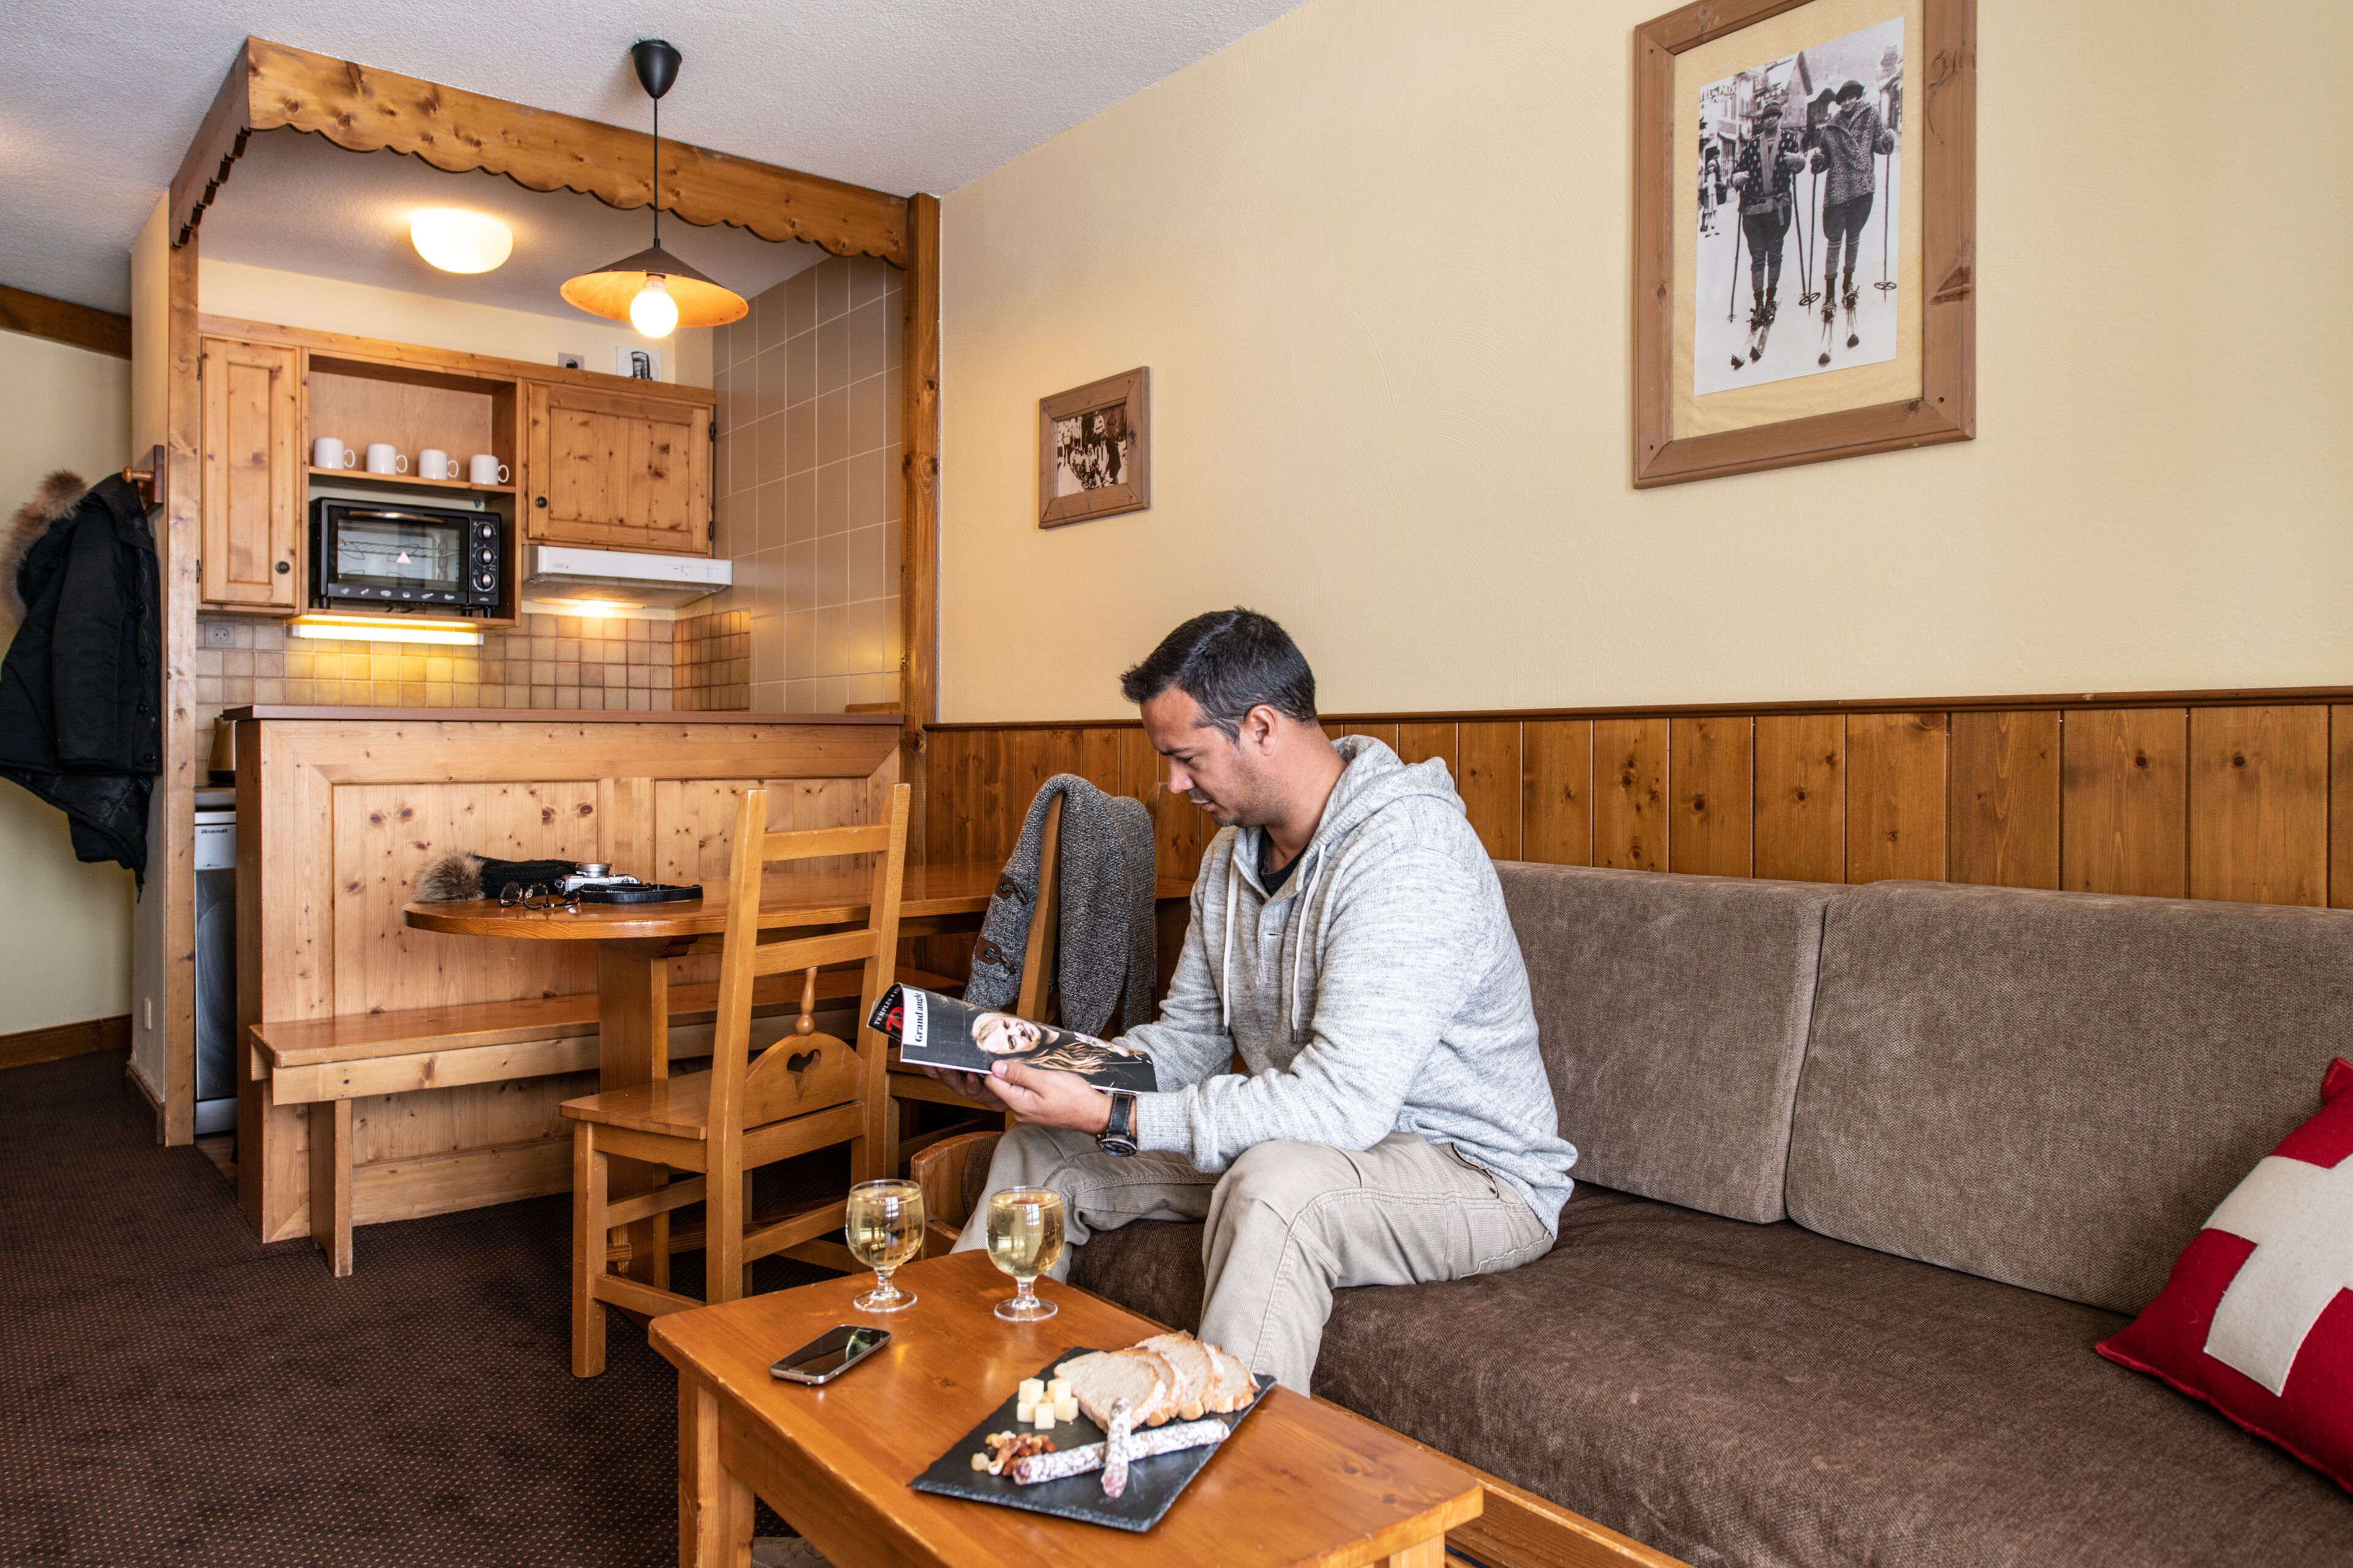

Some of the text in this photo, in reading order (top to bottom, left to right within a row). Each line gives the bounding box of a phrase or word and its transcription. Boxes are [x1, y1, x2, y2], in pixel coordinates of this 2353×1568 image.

[874, 998, 893, 1025] TEMPLES
[914, 993, 924, 1042] Grand angle
